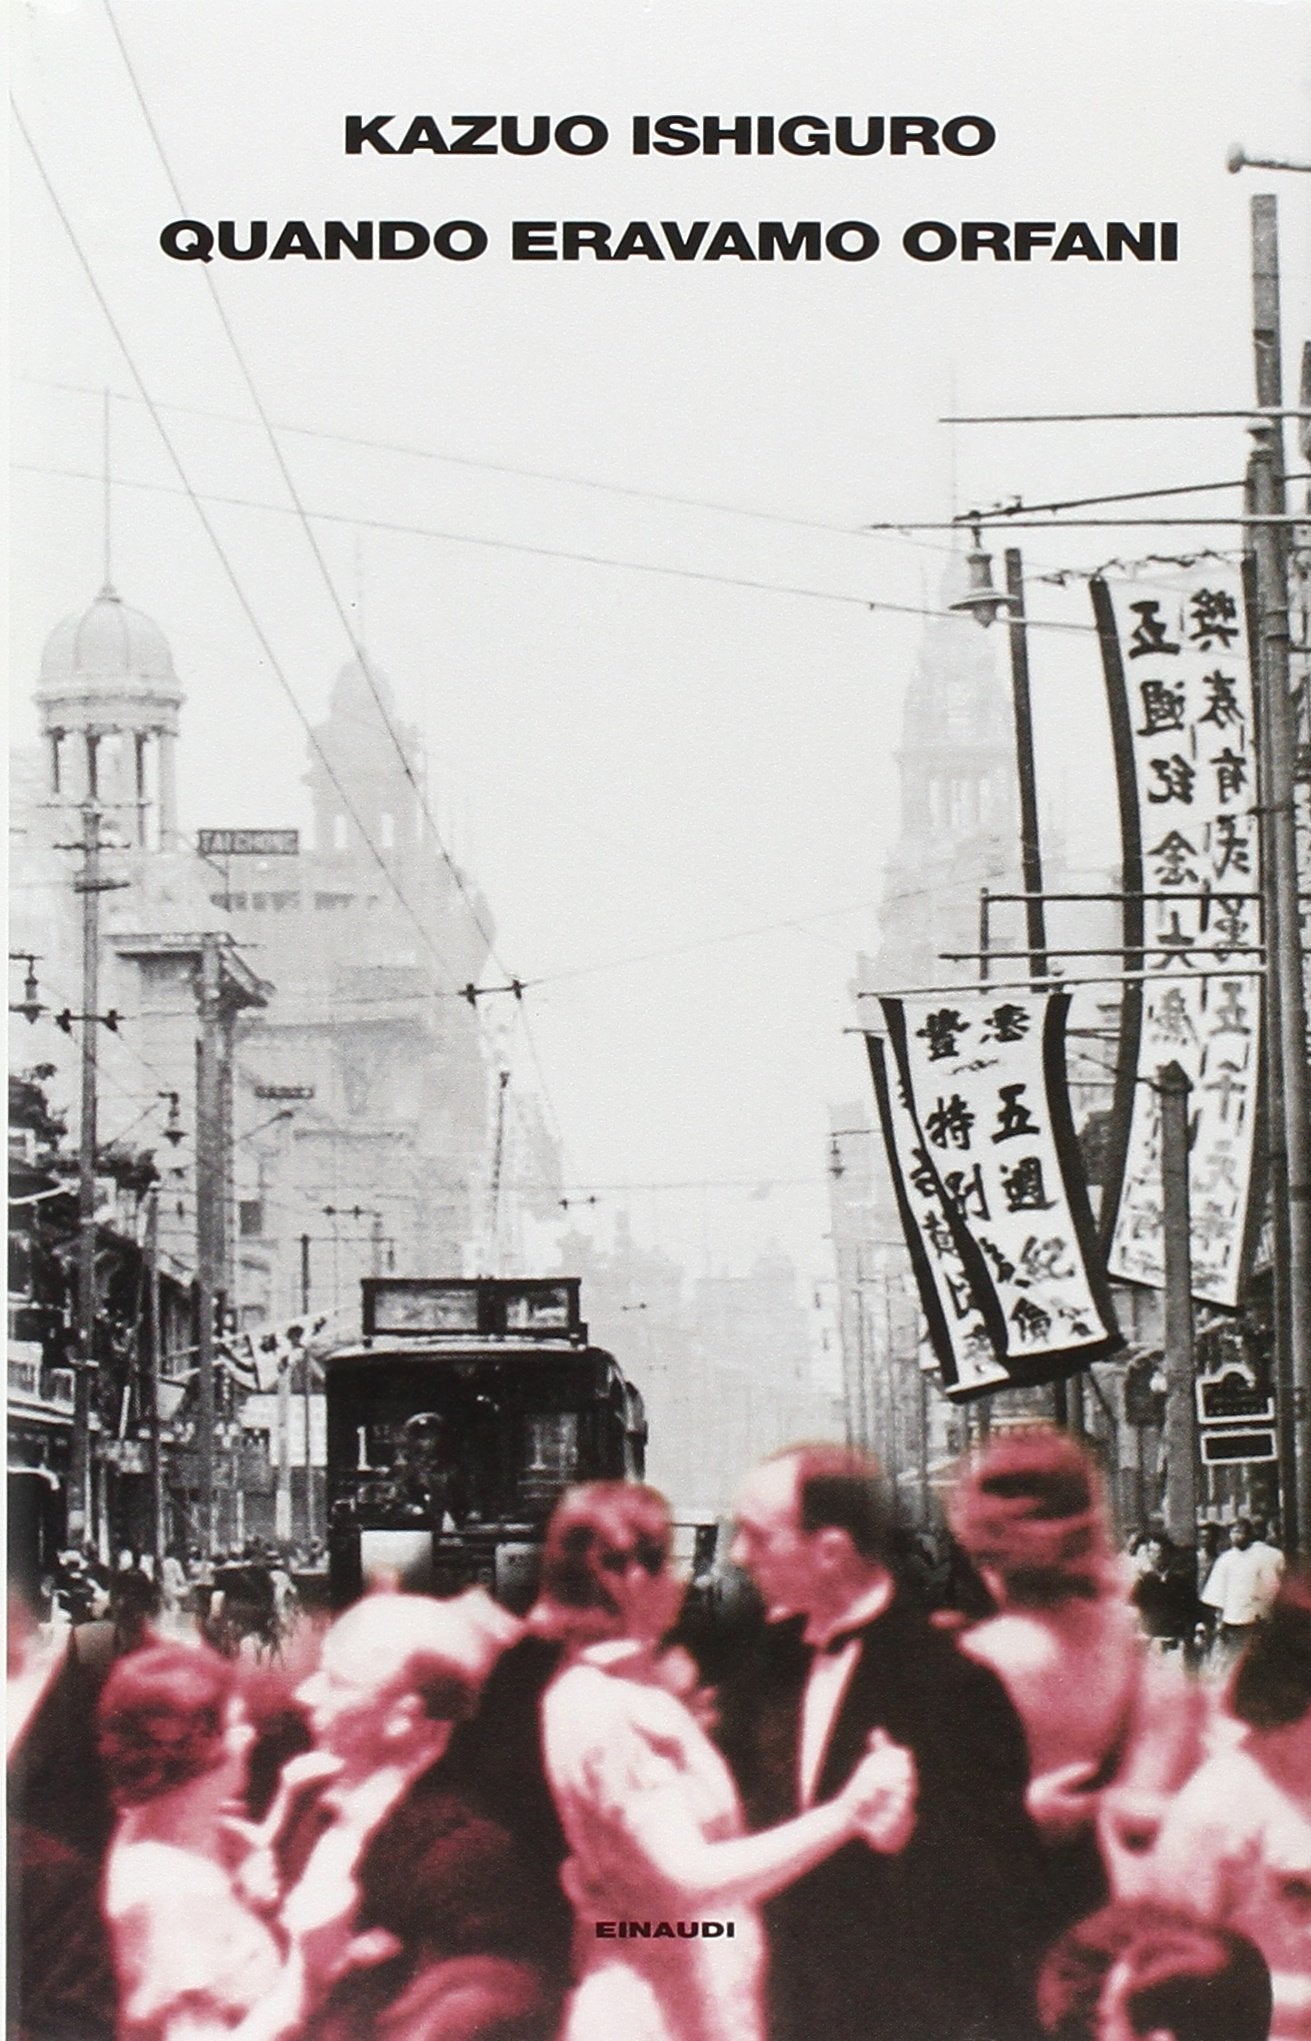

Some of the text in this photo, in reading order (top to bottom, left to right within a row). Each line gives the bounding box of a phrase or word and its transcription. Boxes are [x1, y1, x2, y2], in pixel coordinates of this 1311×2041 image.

[346, 116, 995, 156] KAZUO ISHIGURO
[160, 220, 1177, 262] QUANDO ERAVAMO ORFANI
[596, 1921, 735, 1938] EINAUDI
